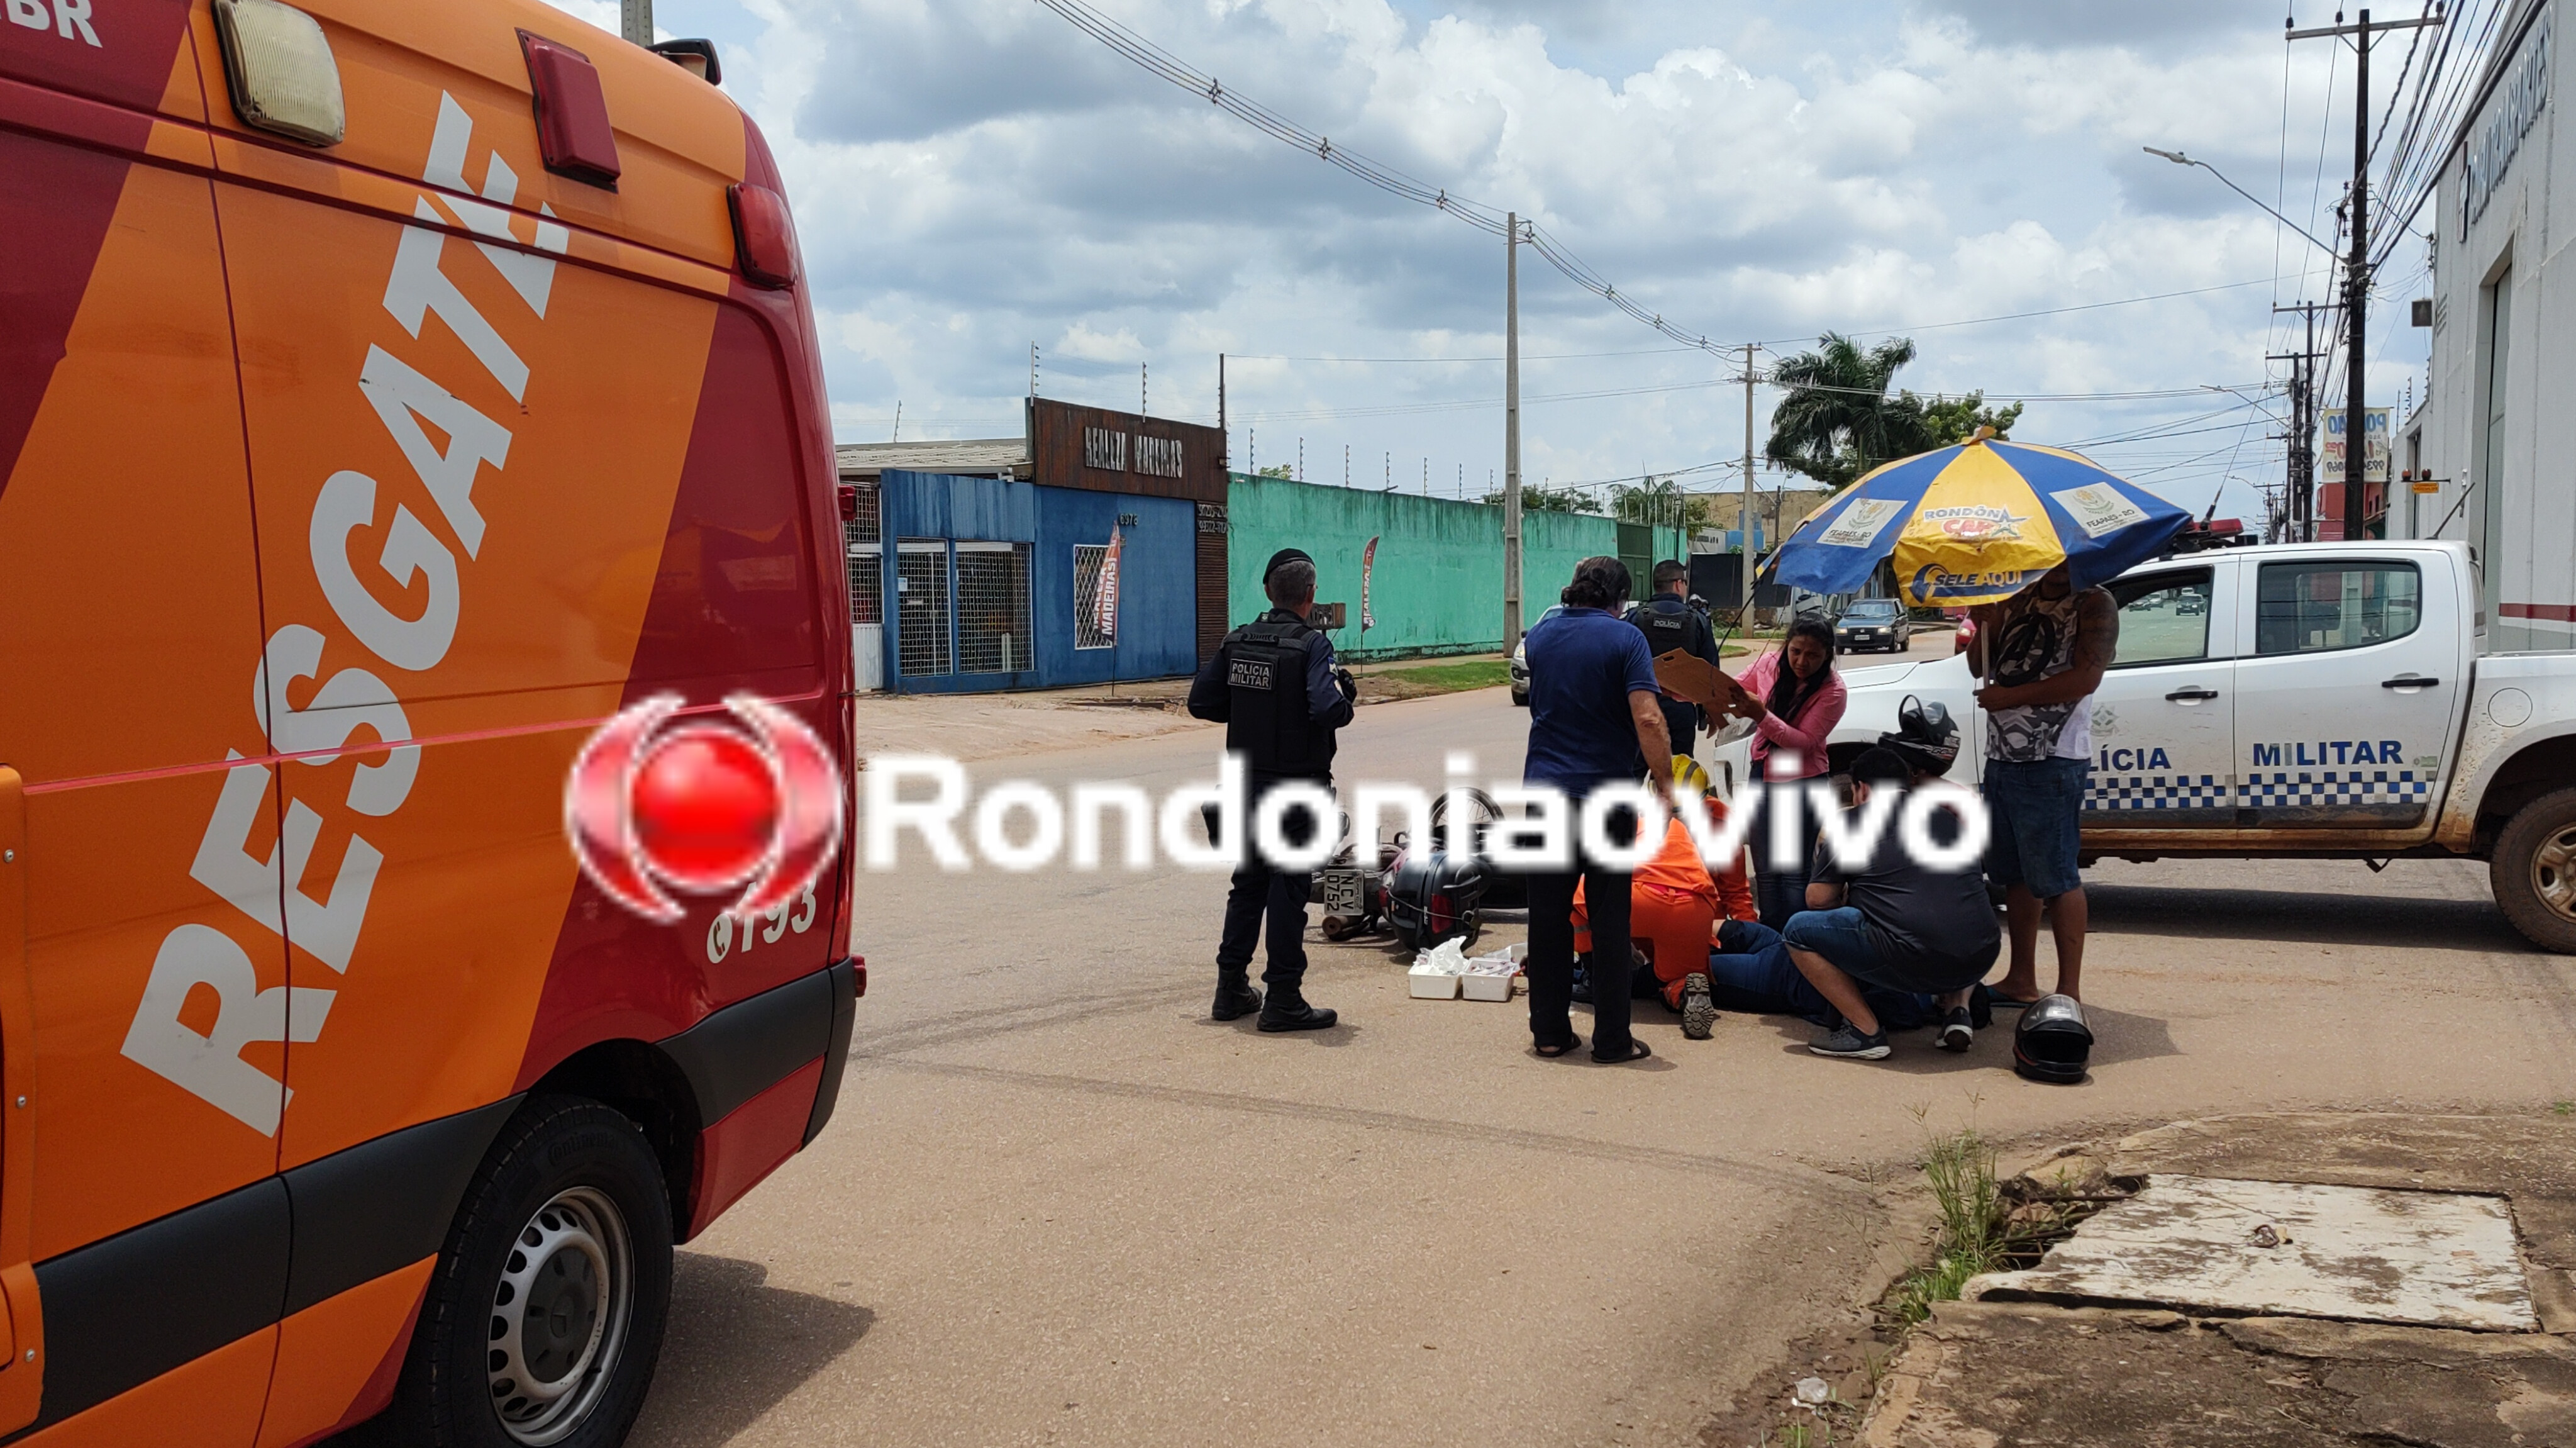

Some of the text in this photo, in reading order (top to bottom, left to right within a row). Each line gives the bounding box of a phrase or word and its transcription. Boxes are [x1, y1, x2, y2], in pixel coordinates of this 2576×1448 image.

[1085, 426, 1182, 478] REALEZA MADEIRAS
[2122, 509, 2135, 517] RO
[1933, 571, 2023, 587] SELE AQUI
[120, 90, 569, 1137] RESGATE
[1101, 561, 1117, 635] MADEIRAS
[1654, 618, 1681, 628] POLÍCIA
[1231, 673, 1269, 688] MILITAR
[1232, 662, 1270, 677] POLÍCIA
[2089, 740, 2404, 772] ÍCIA MILITAR
[1327, 875, 1340, 911] 0752
[1340, 876, 1354, 910] NCV
[735, 872, 817, 954] 193
